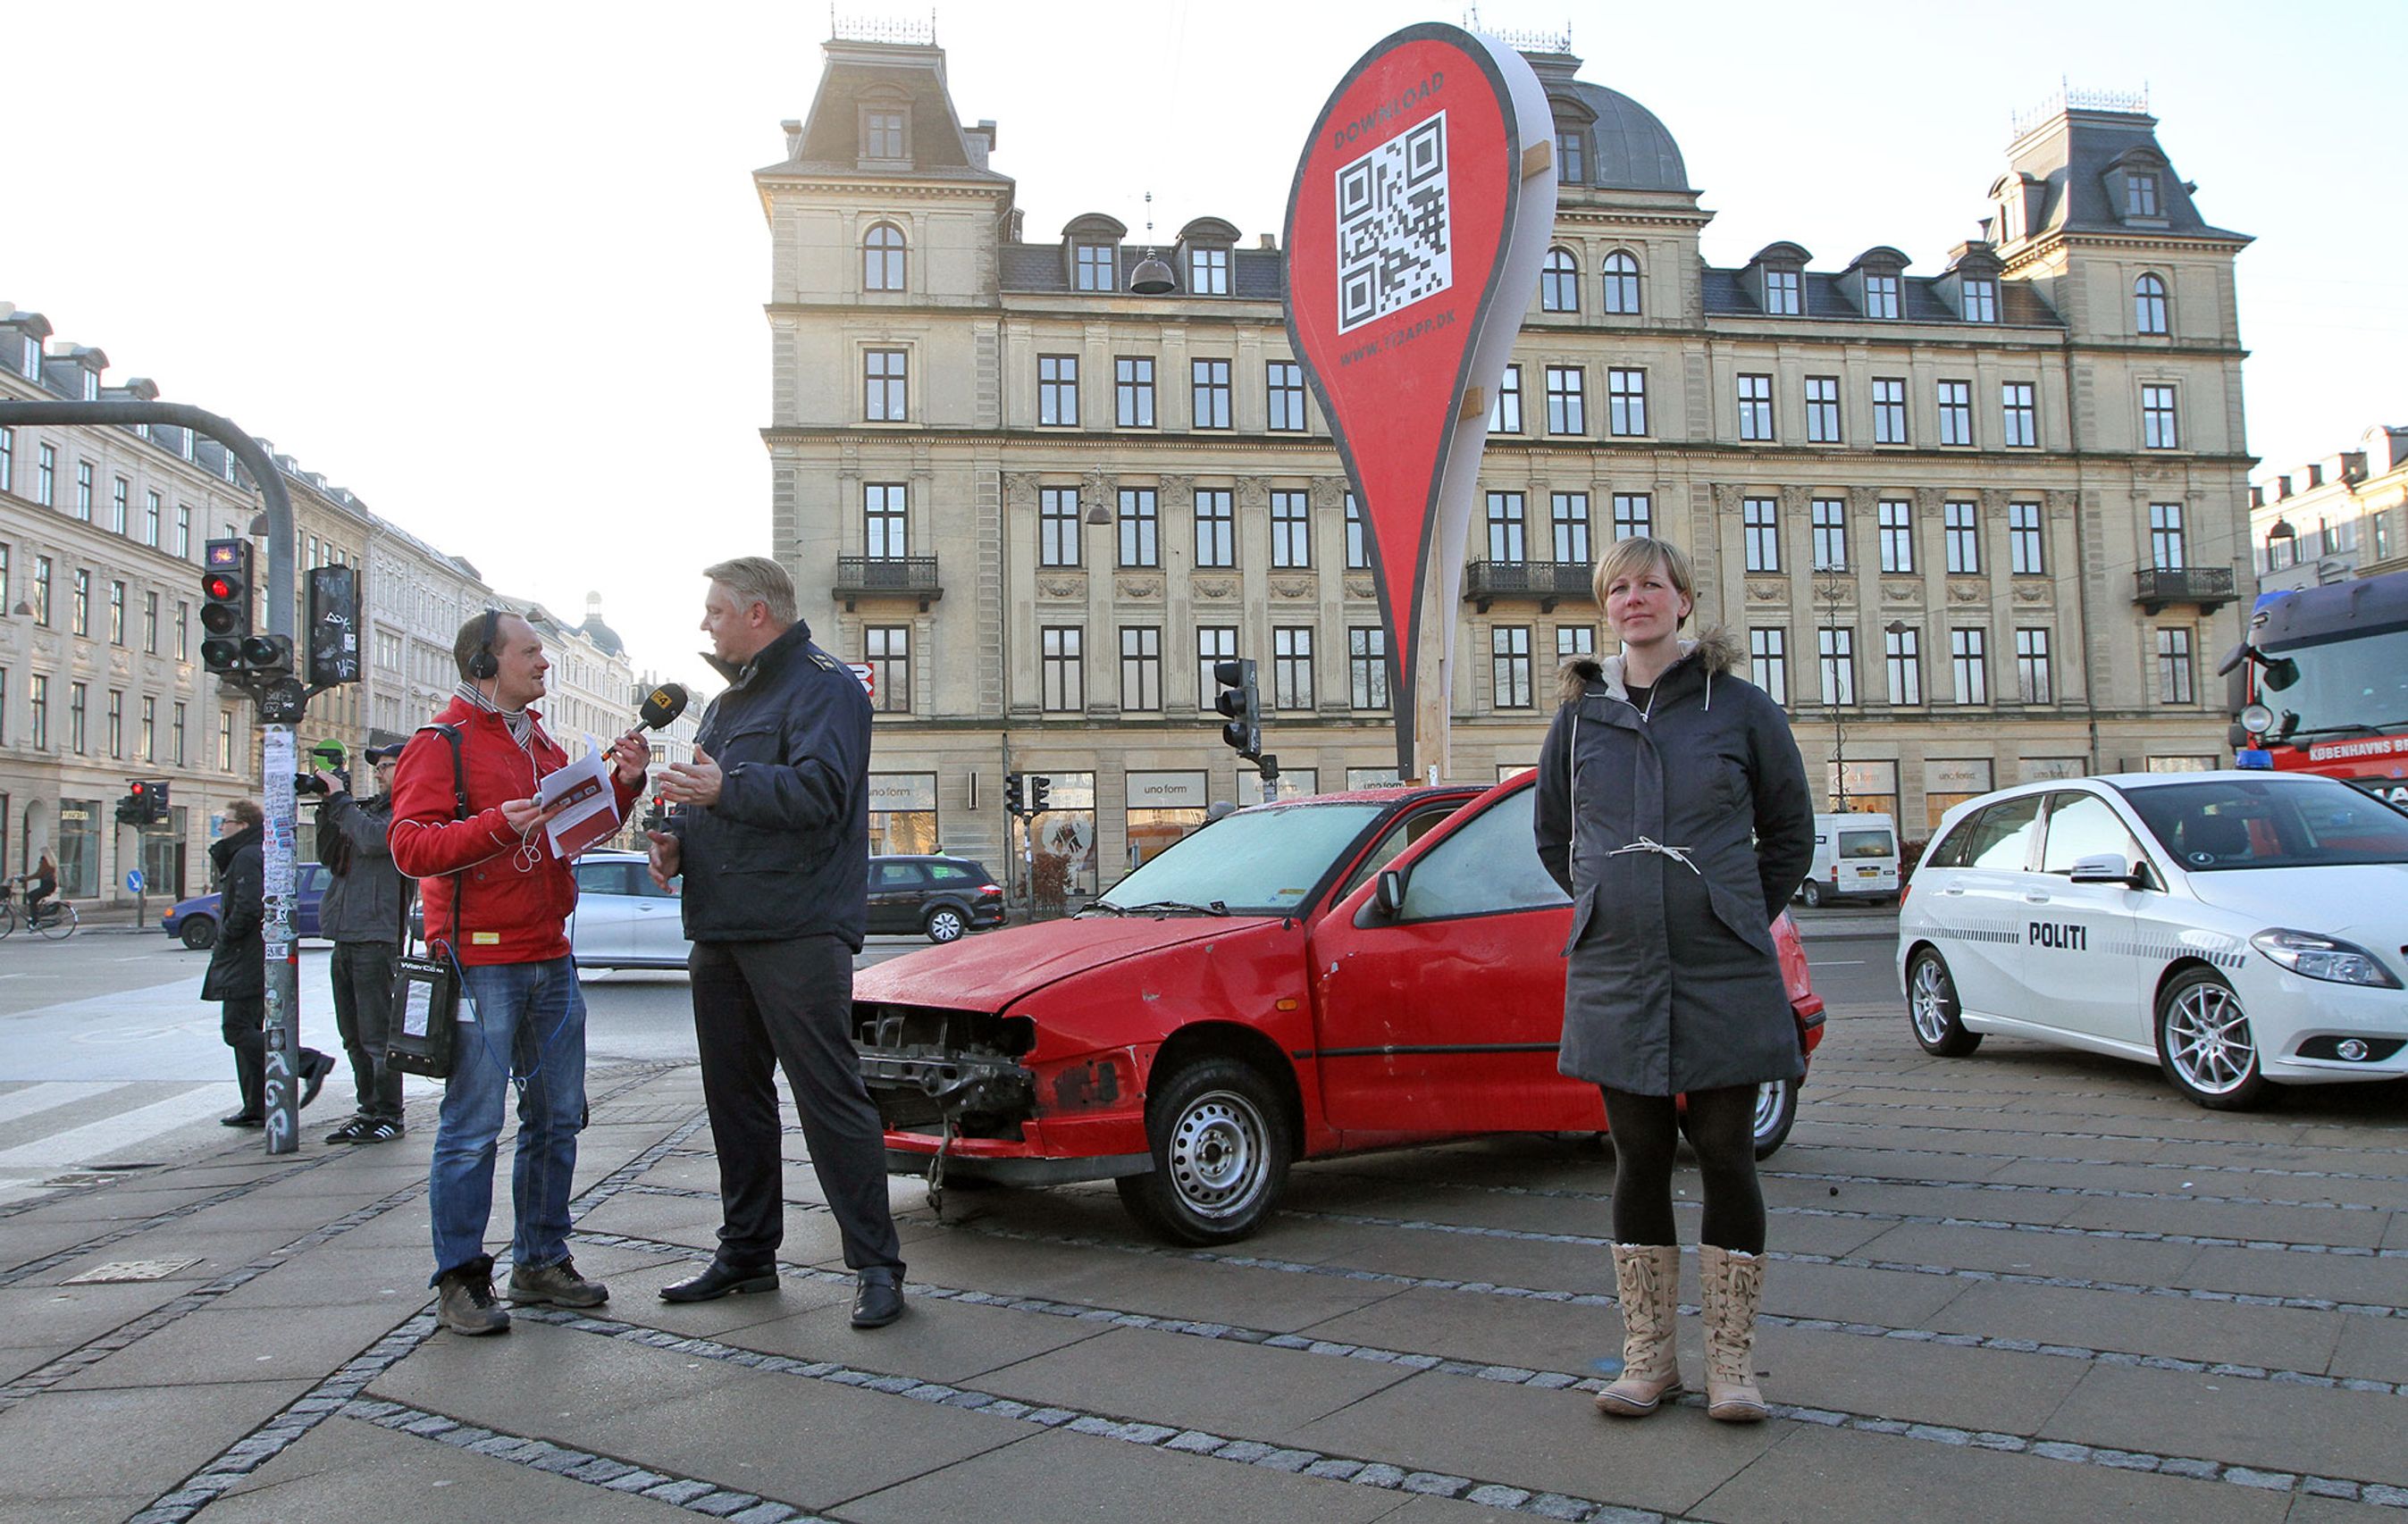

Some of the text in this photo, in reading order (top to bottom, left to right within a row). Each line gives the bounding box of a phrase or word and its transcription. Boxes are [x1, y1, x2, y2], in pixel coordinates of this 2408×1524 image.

[1333, 71, 1444, 150] DOWNLOAD
[2310, 741, 2391, 761] KØBENHAVNS
[885, 786, 910, 796] form
[1144, 783, 1187, 794] uno form
[2029, 922, 2086, 950] POLITI
